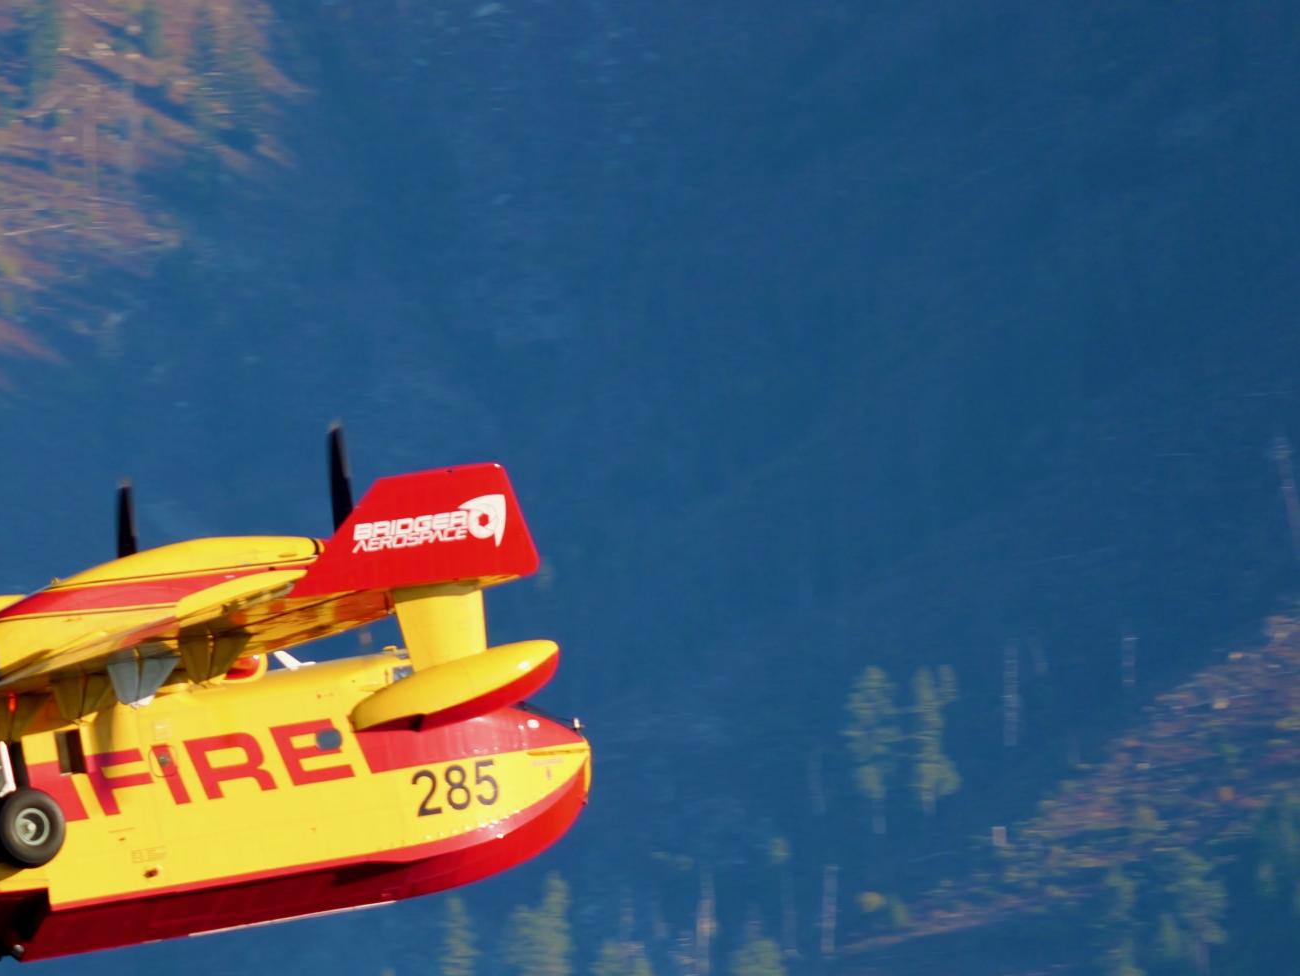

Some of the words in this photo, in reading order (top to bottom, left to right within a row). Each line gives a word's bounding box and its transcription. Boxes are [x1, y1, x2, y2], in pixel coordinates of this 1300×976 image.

[352, 529, 467, 554] AEROSPACE
[353, 511, 468, 541] BRIDGER
[88, 719, 355, 815] FIRE
[411, 760, 499, 817] 285
